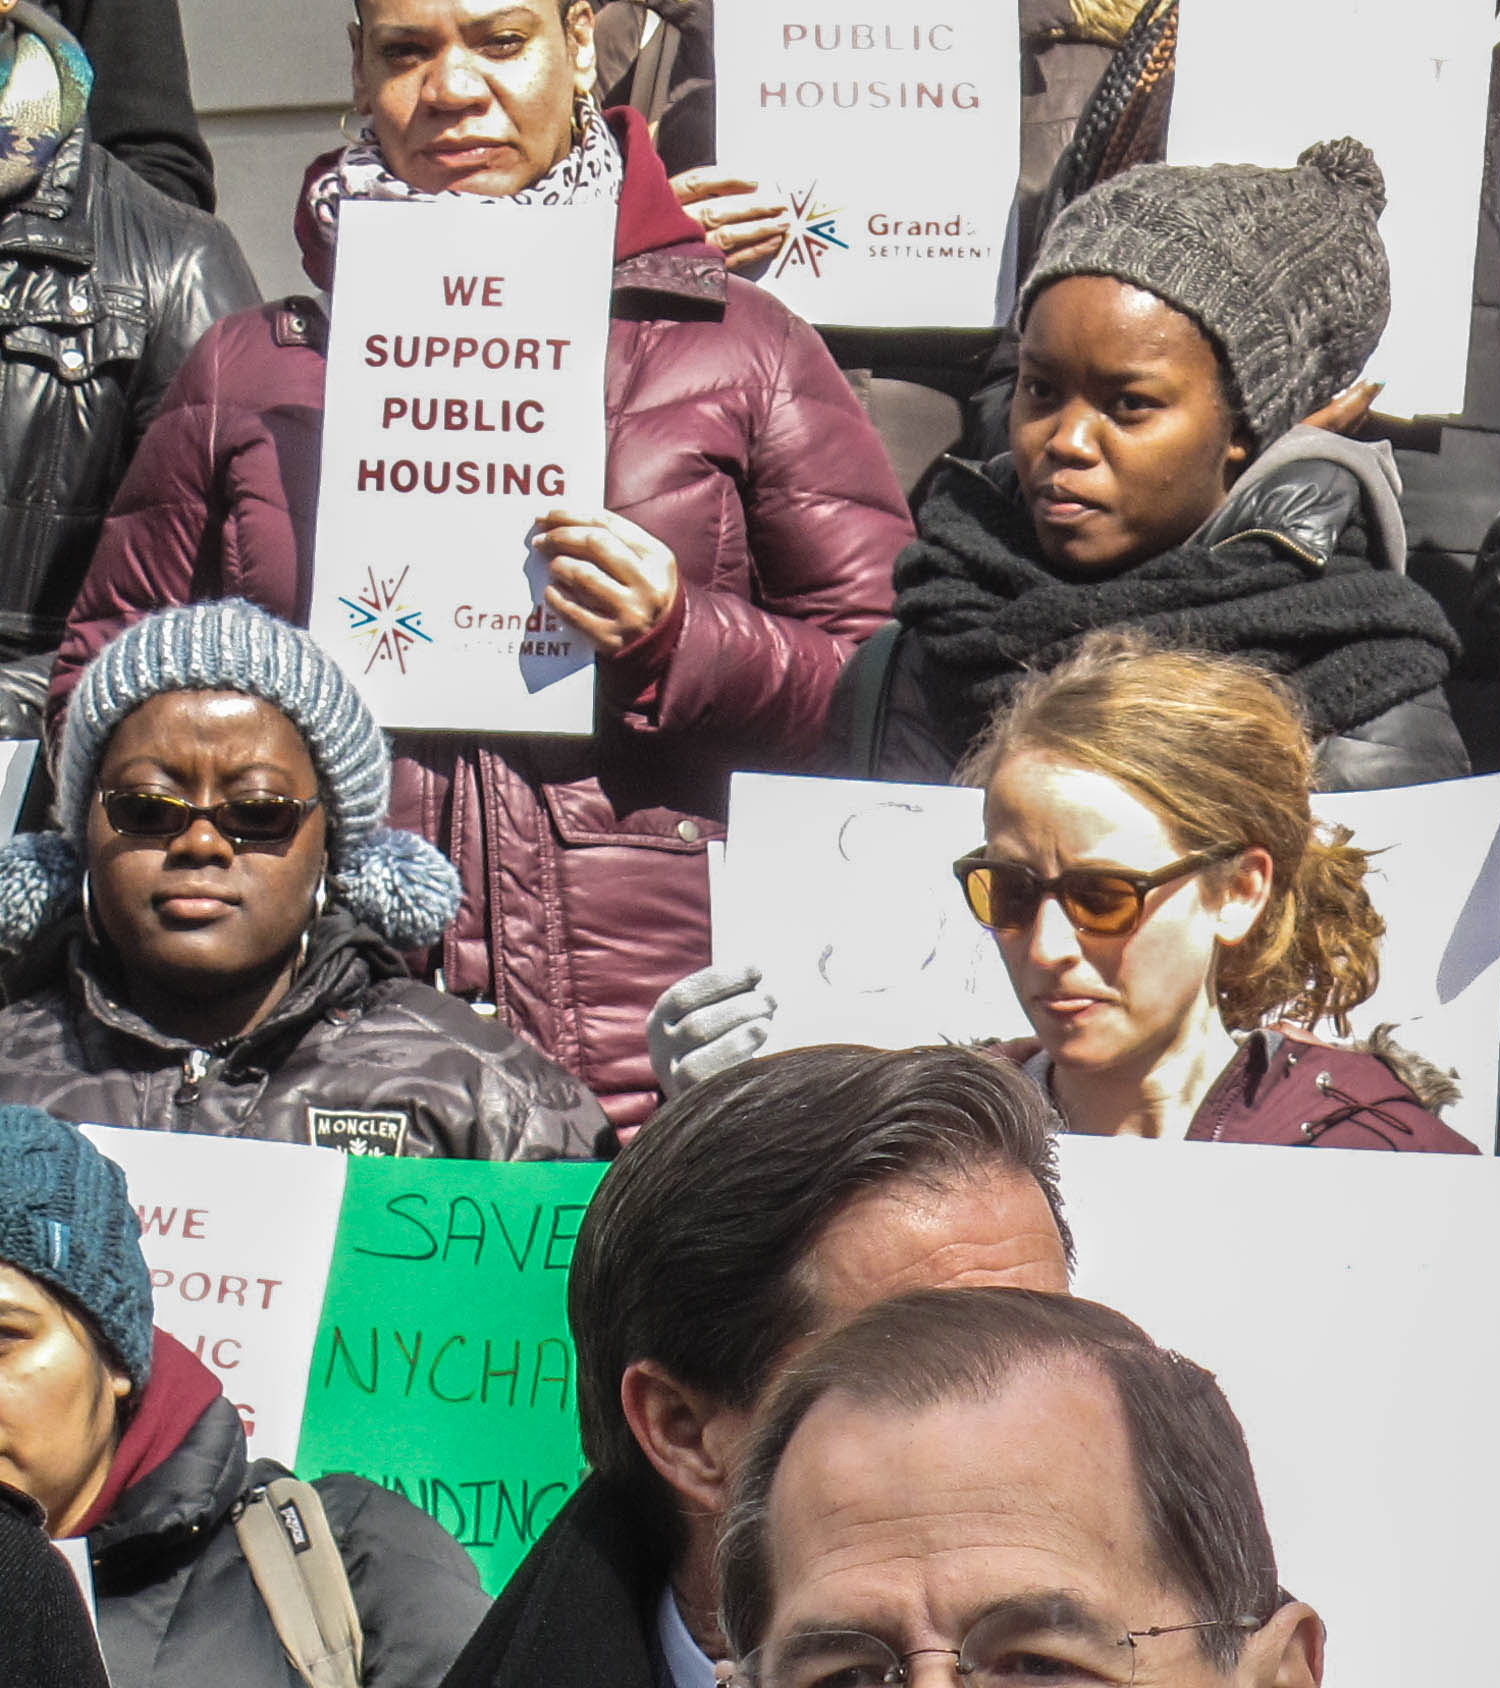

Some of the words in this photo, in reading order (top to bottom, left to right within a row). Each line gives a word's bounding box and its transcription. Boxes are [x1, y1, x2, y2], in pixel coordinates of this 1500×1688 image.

[782, 23, 954, 51] PUBLIC
[759, 80, 980, 109] HOUSING
[867, 213, 961, 236] Grand
[868, 245, 991, 259] SETTLEMENT
[443, 275, 505, 307] WE
[364, 333, 571, 371] SUPPORT
[381, 396, 545, 434] PUBLIC
[357, 458, 566, 497] HOUSING
[317, 1118, 399, 1140] MONCLER
[139, 1205, 209, 1240] WE
[352, 1193, 589, 1273] SAVE
[150, 1268, 283, 1310] PORT
[323, 1325, 572, 1413] NYCHA
